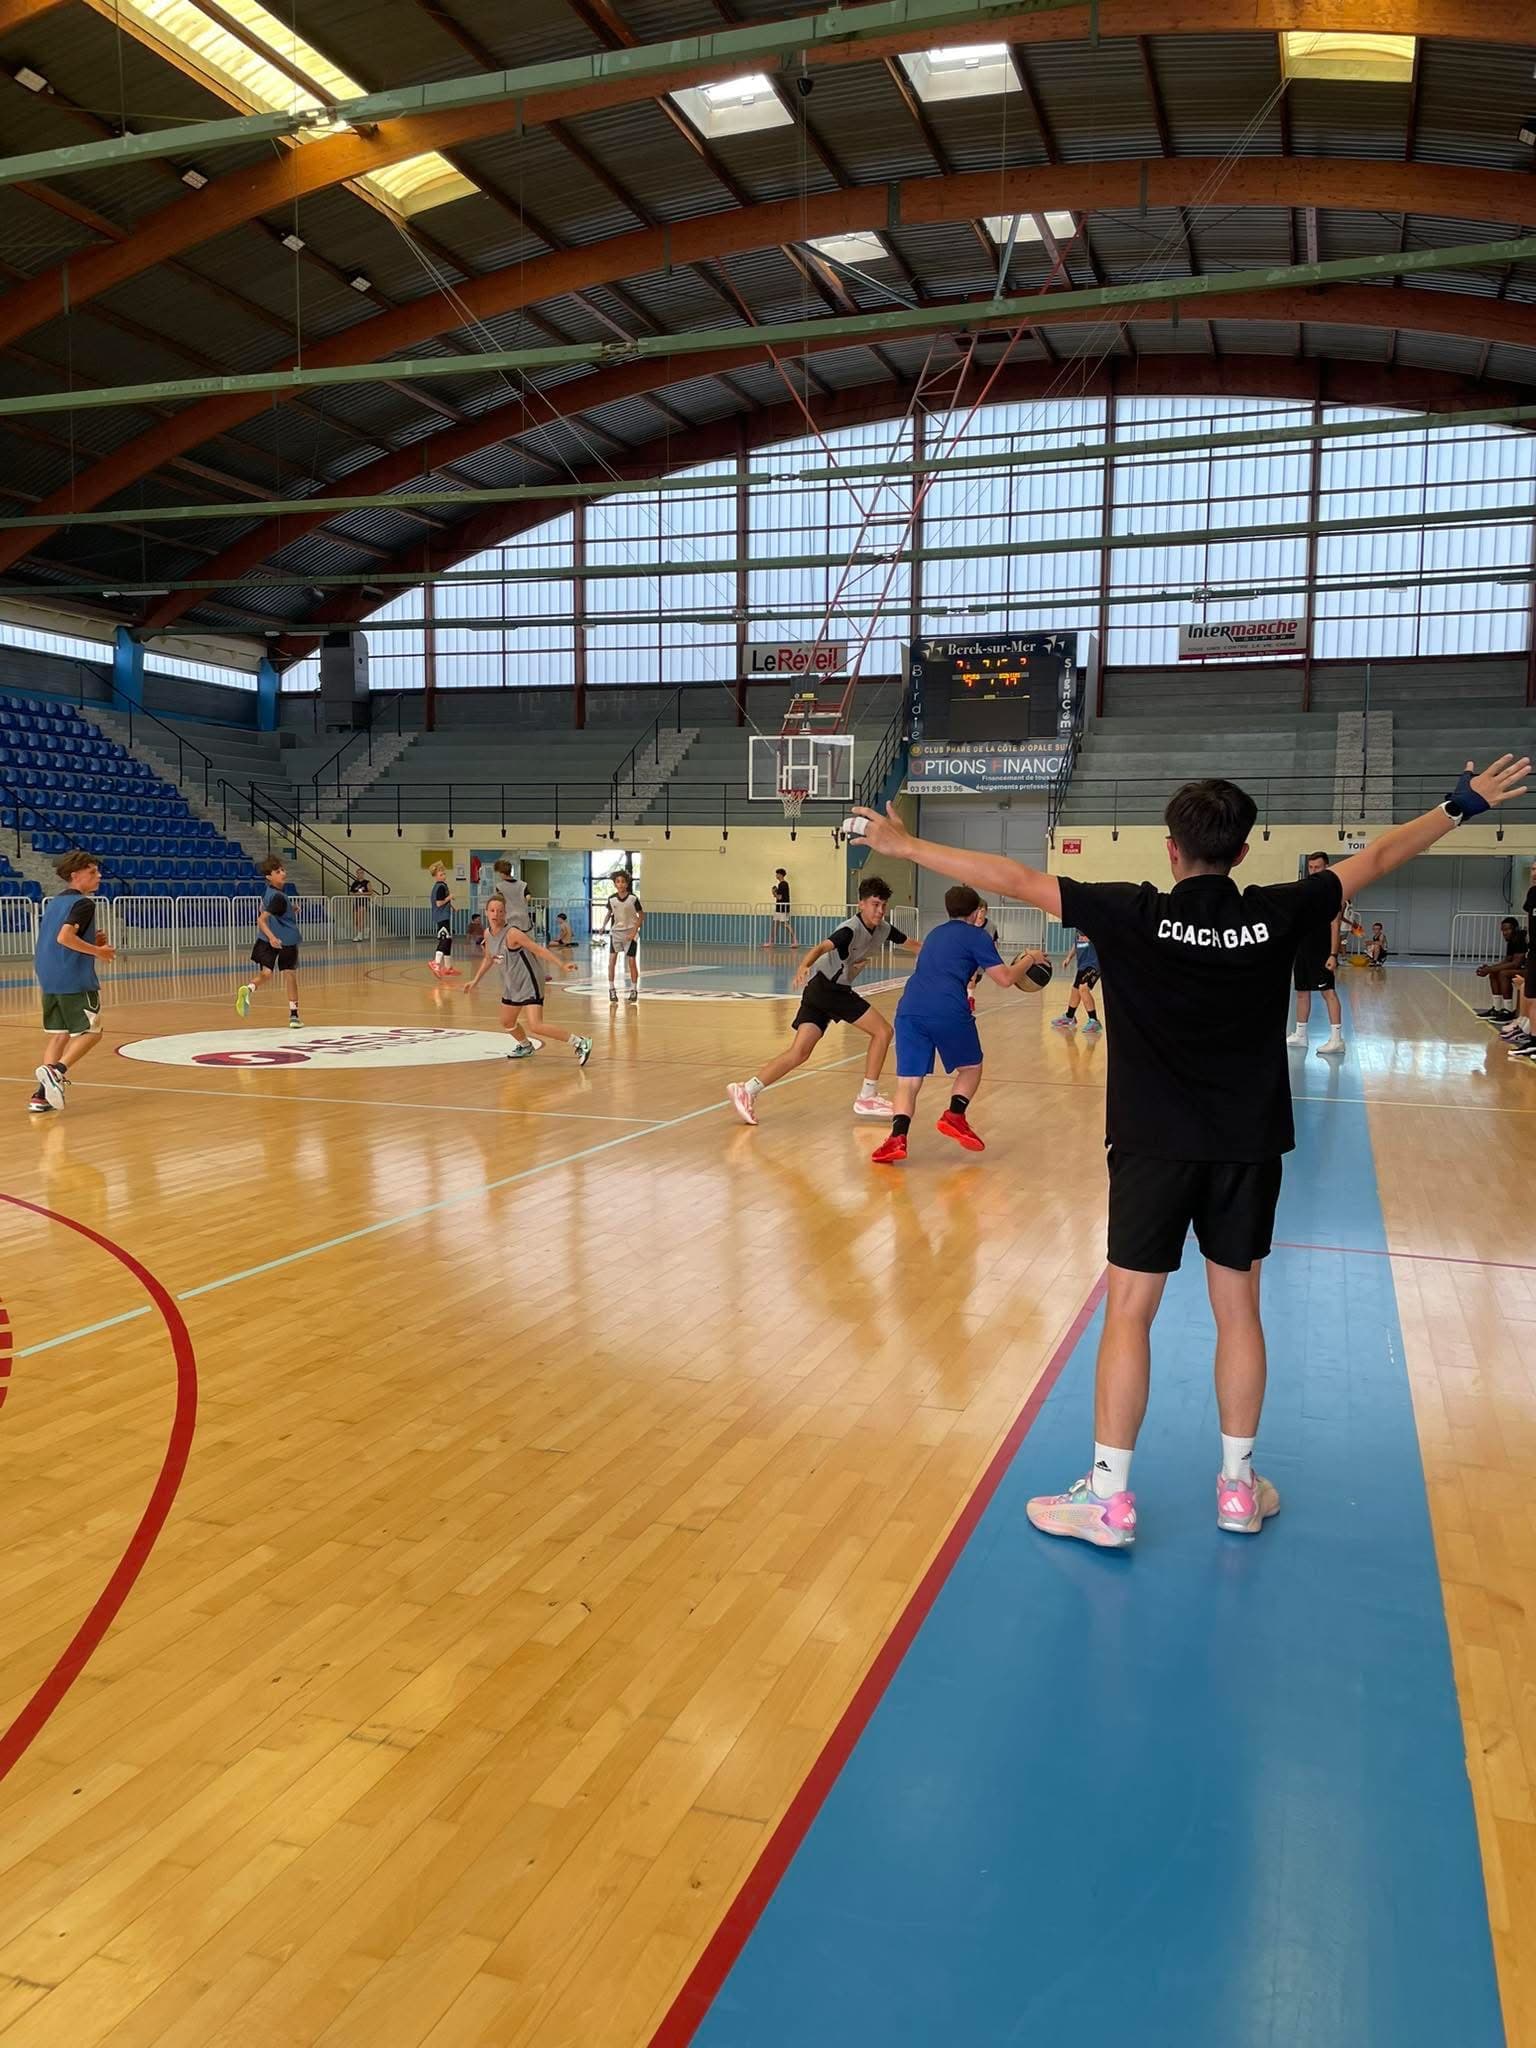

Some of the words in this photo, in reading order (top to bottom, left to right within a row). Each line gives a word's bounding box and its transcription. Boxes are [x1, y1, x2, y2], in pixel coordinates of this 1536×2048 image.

[948, 640, 1036, 656] Berck-sur-Mer
[912, 664, 922, 740] Birdie
[924, 746, 944, 754] CLUB
[973, 745, 984, 753] DE
[985, 745, 996, 753] LA
[1020, 743, 1053, 752] D'OPALE
[911, 759, 986, 775] OPTIONS
[1223, 922, 1270, 949] GAB
